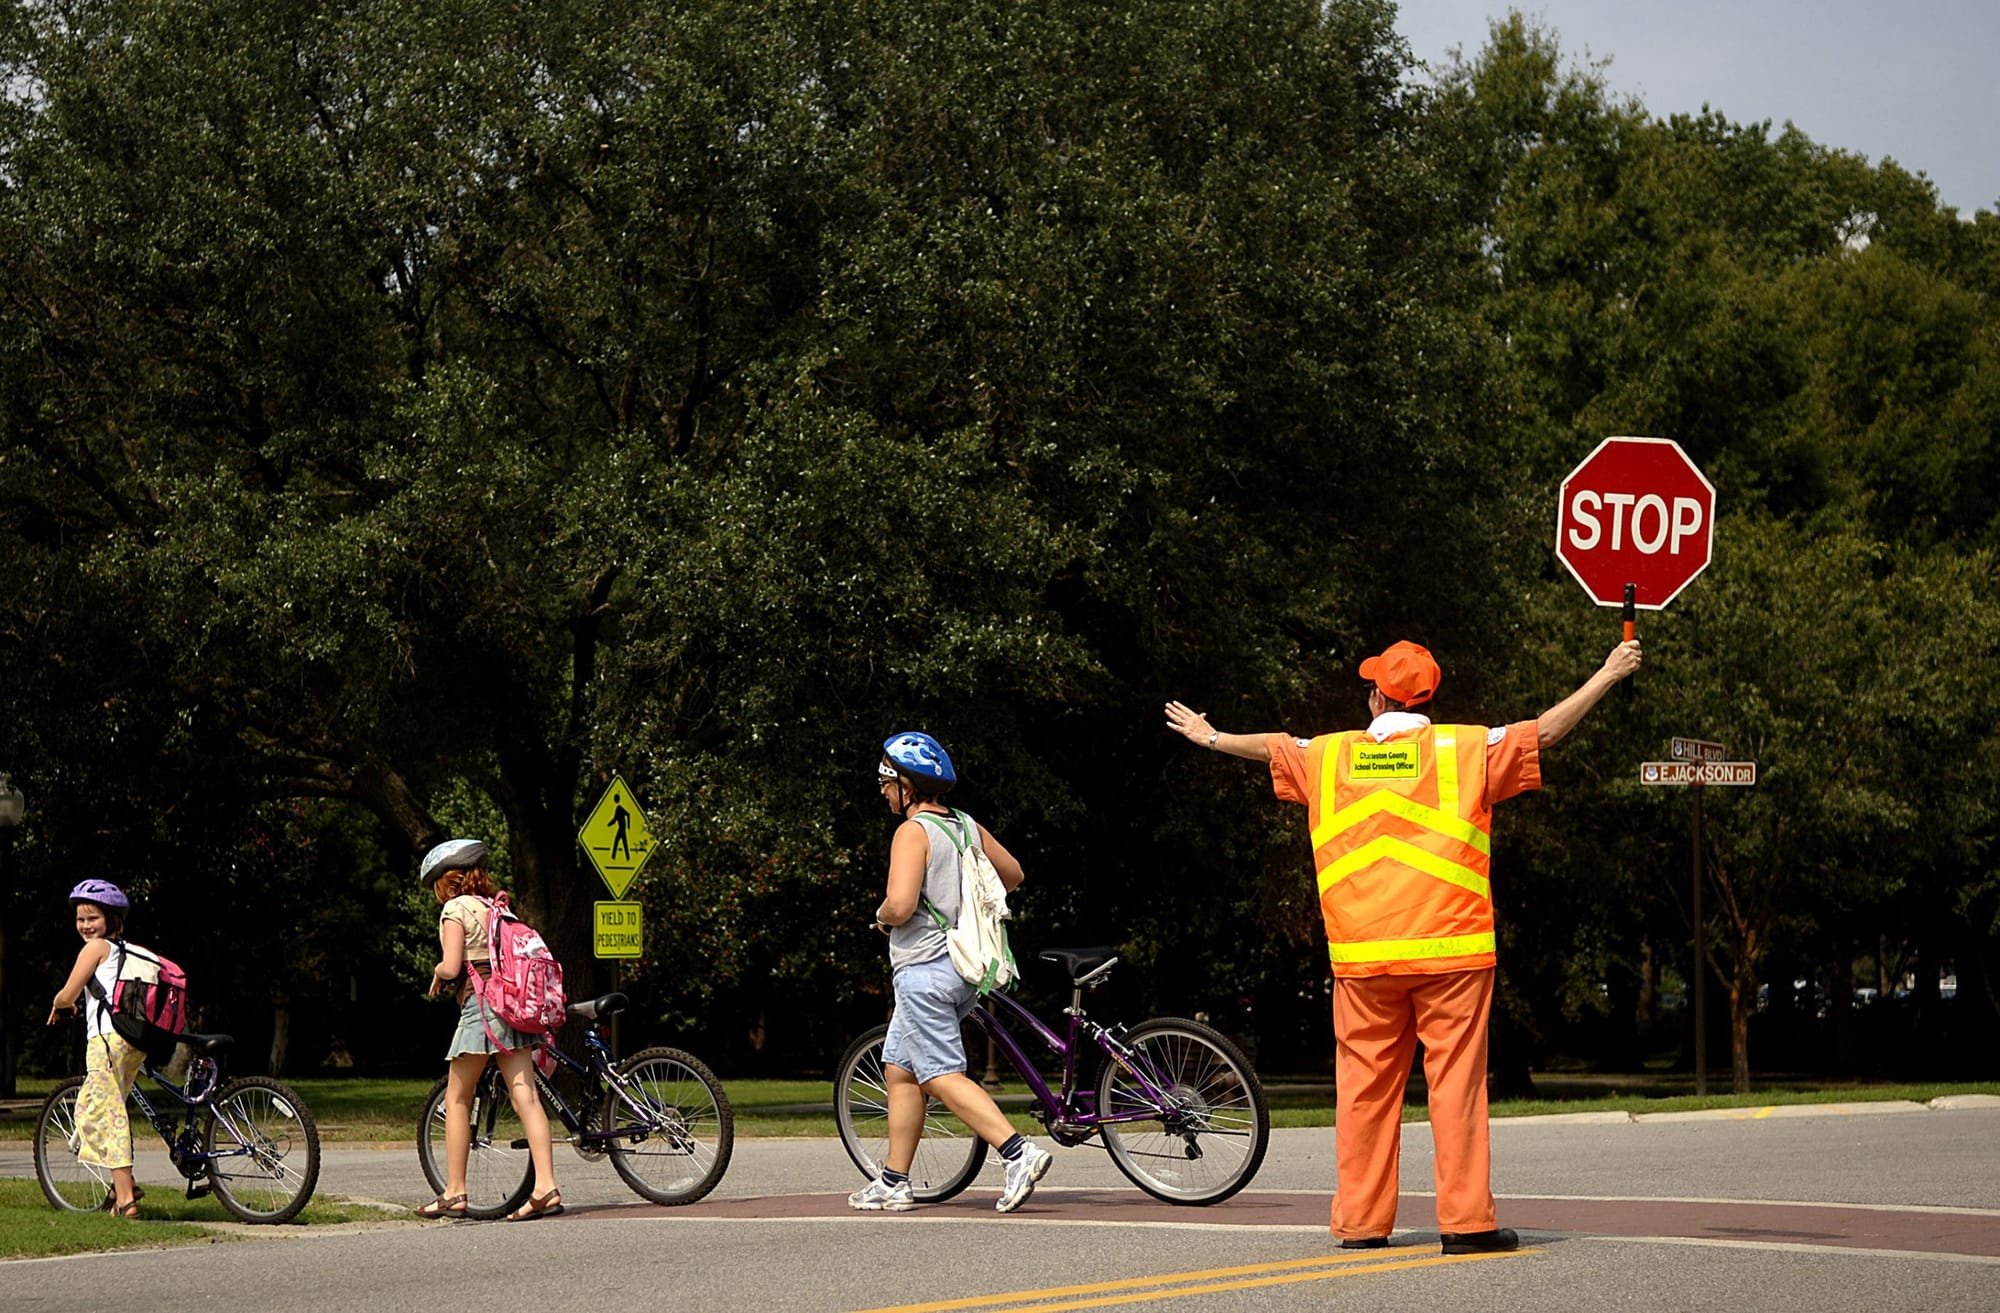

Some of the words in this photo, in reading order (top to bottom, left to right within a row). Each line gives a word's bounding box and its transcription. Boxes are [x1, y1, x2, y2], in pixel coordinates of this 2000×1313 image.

[1569, 489, 1703, 555] STOP
[1388, 751, 1408, 761] County
[1683, 741, 1703, 760] HILL
[1704, 748, 1723, 761] BLVD
[1354, 763, 1371, 771] School
[1372, 762, 1395, 771] Crossing
[1396, 762, 1414, 770] Officer
[1736, 769, 1751, 781] DR
[601, 911, 624, 926] YIELD
[627, 911, 637, 926] TO
[598, 933, 639, 947] PEDESTRIANS
